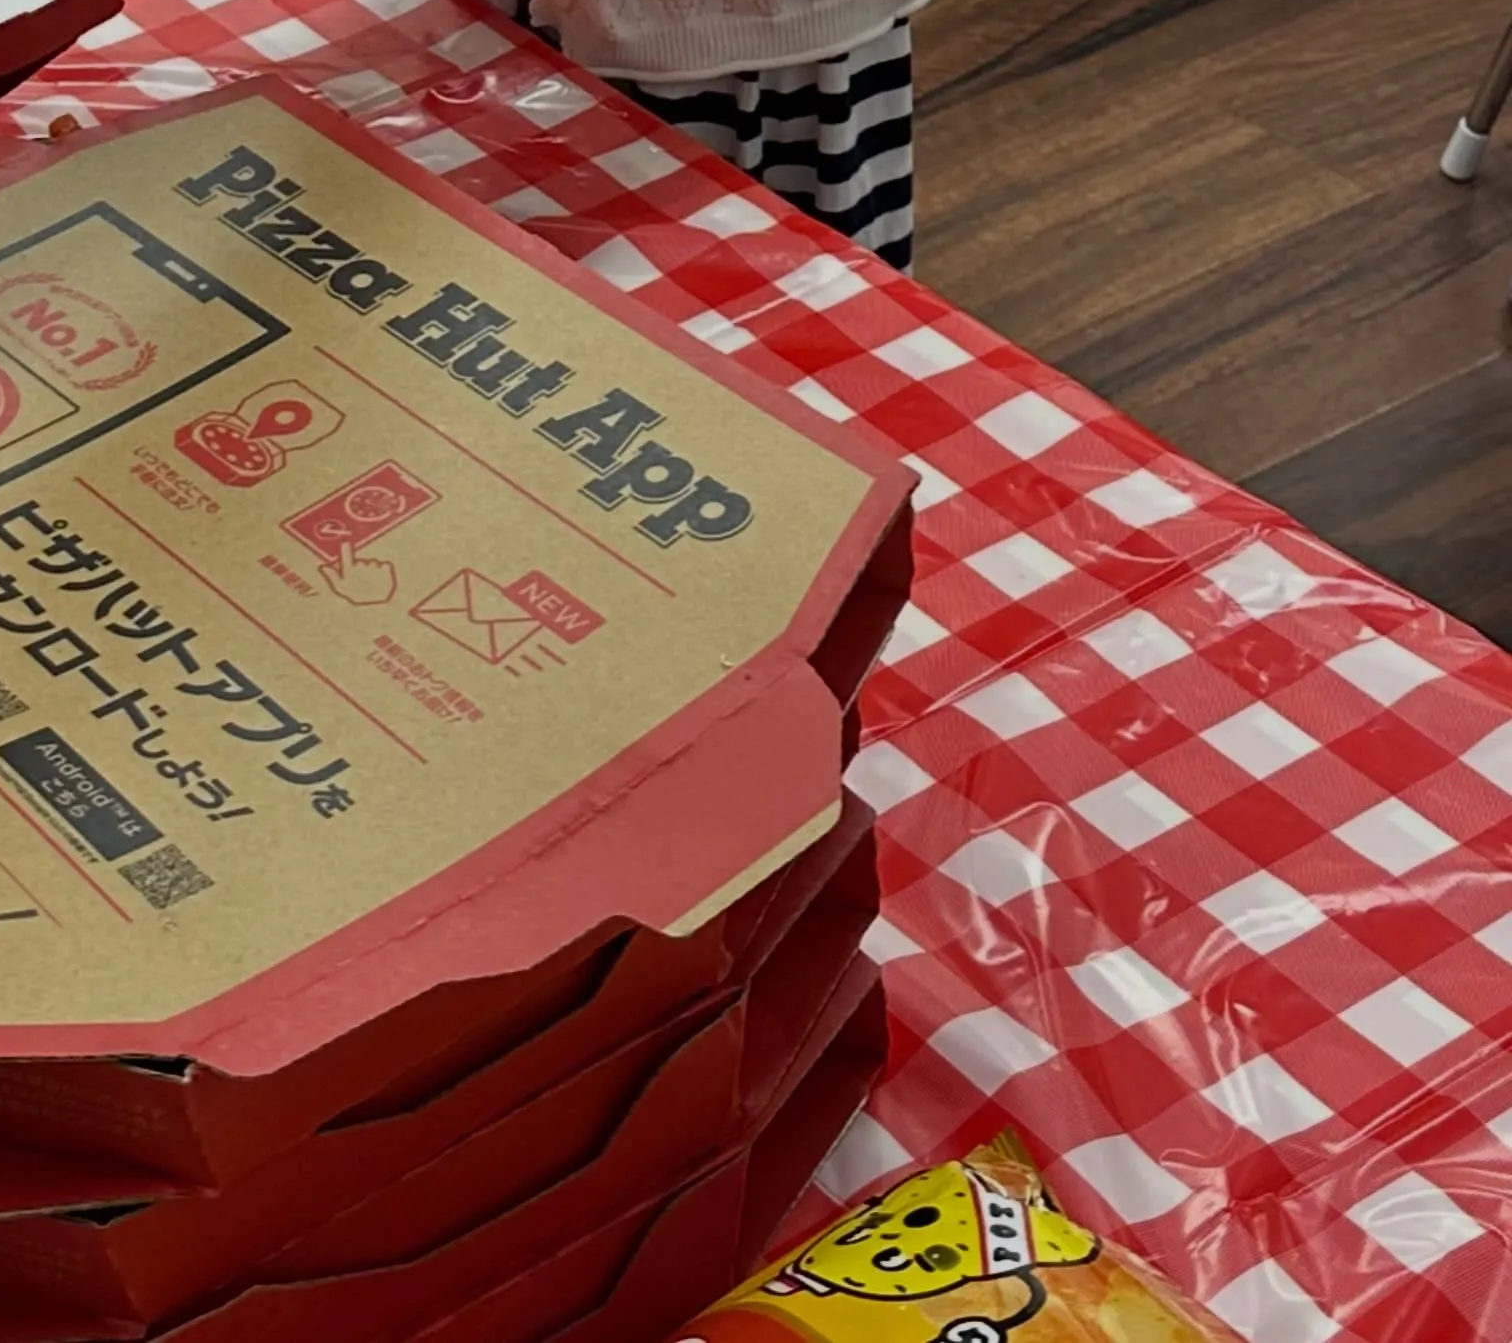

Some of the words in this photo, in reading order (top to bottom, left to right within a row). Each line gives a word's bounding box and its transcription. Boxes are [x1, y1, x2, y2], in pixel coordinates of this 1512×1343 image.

[9, 296, 121, 368] No.1
[172, 145, 412, 314] Pizza
[382, 282, 576, 417] Hut
[533, 387, 755, 549] App
[518, 580, 591, 631] NEW
[40, 777, 89, 821] こちら
